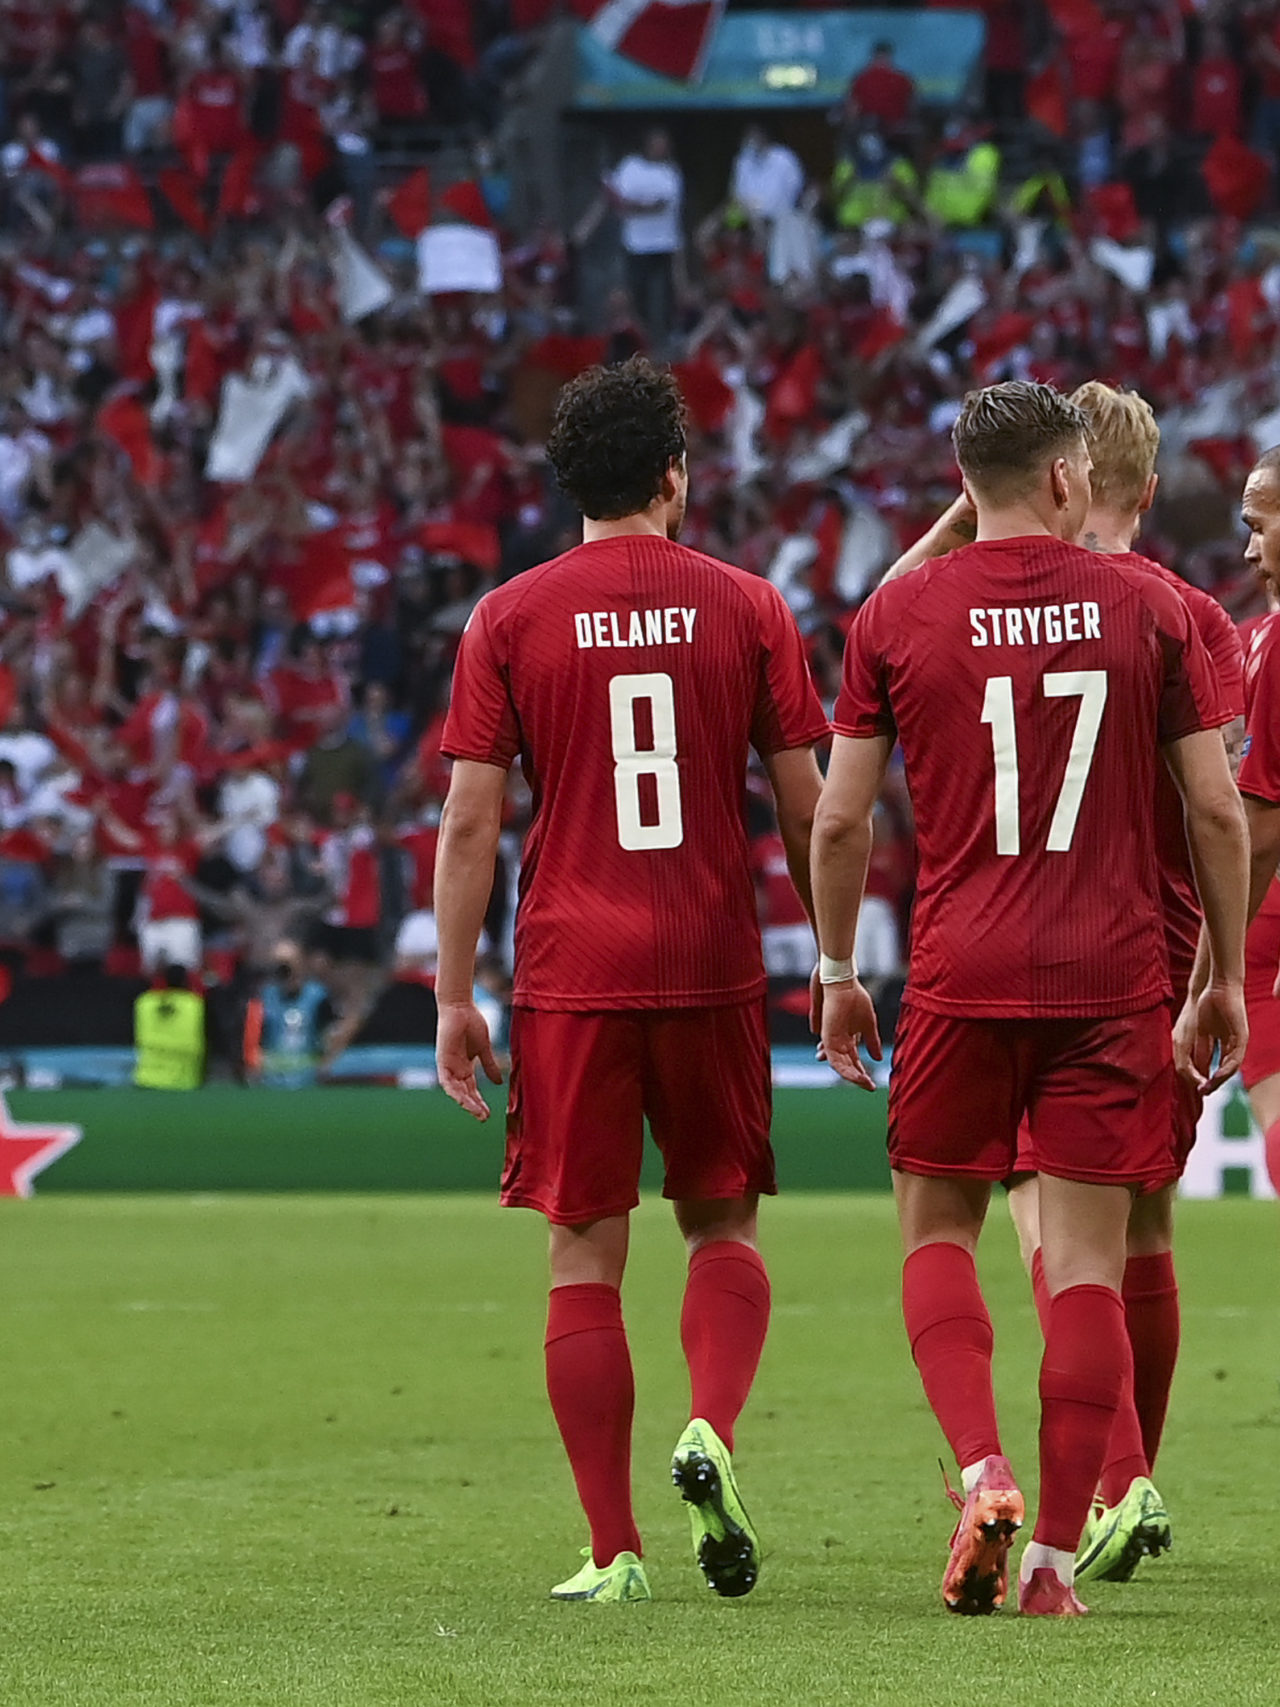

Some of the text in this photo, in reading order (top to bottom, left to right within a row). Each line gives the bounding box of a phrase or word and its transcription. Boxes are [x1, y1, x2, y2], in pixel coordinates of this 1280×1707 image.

[574, 607, 698, 650] DELANEY
[969, 601, 1102, 647] STRYGER
[609, 672, 684, 852] 8
[980, 669, 1109, 857] 17
